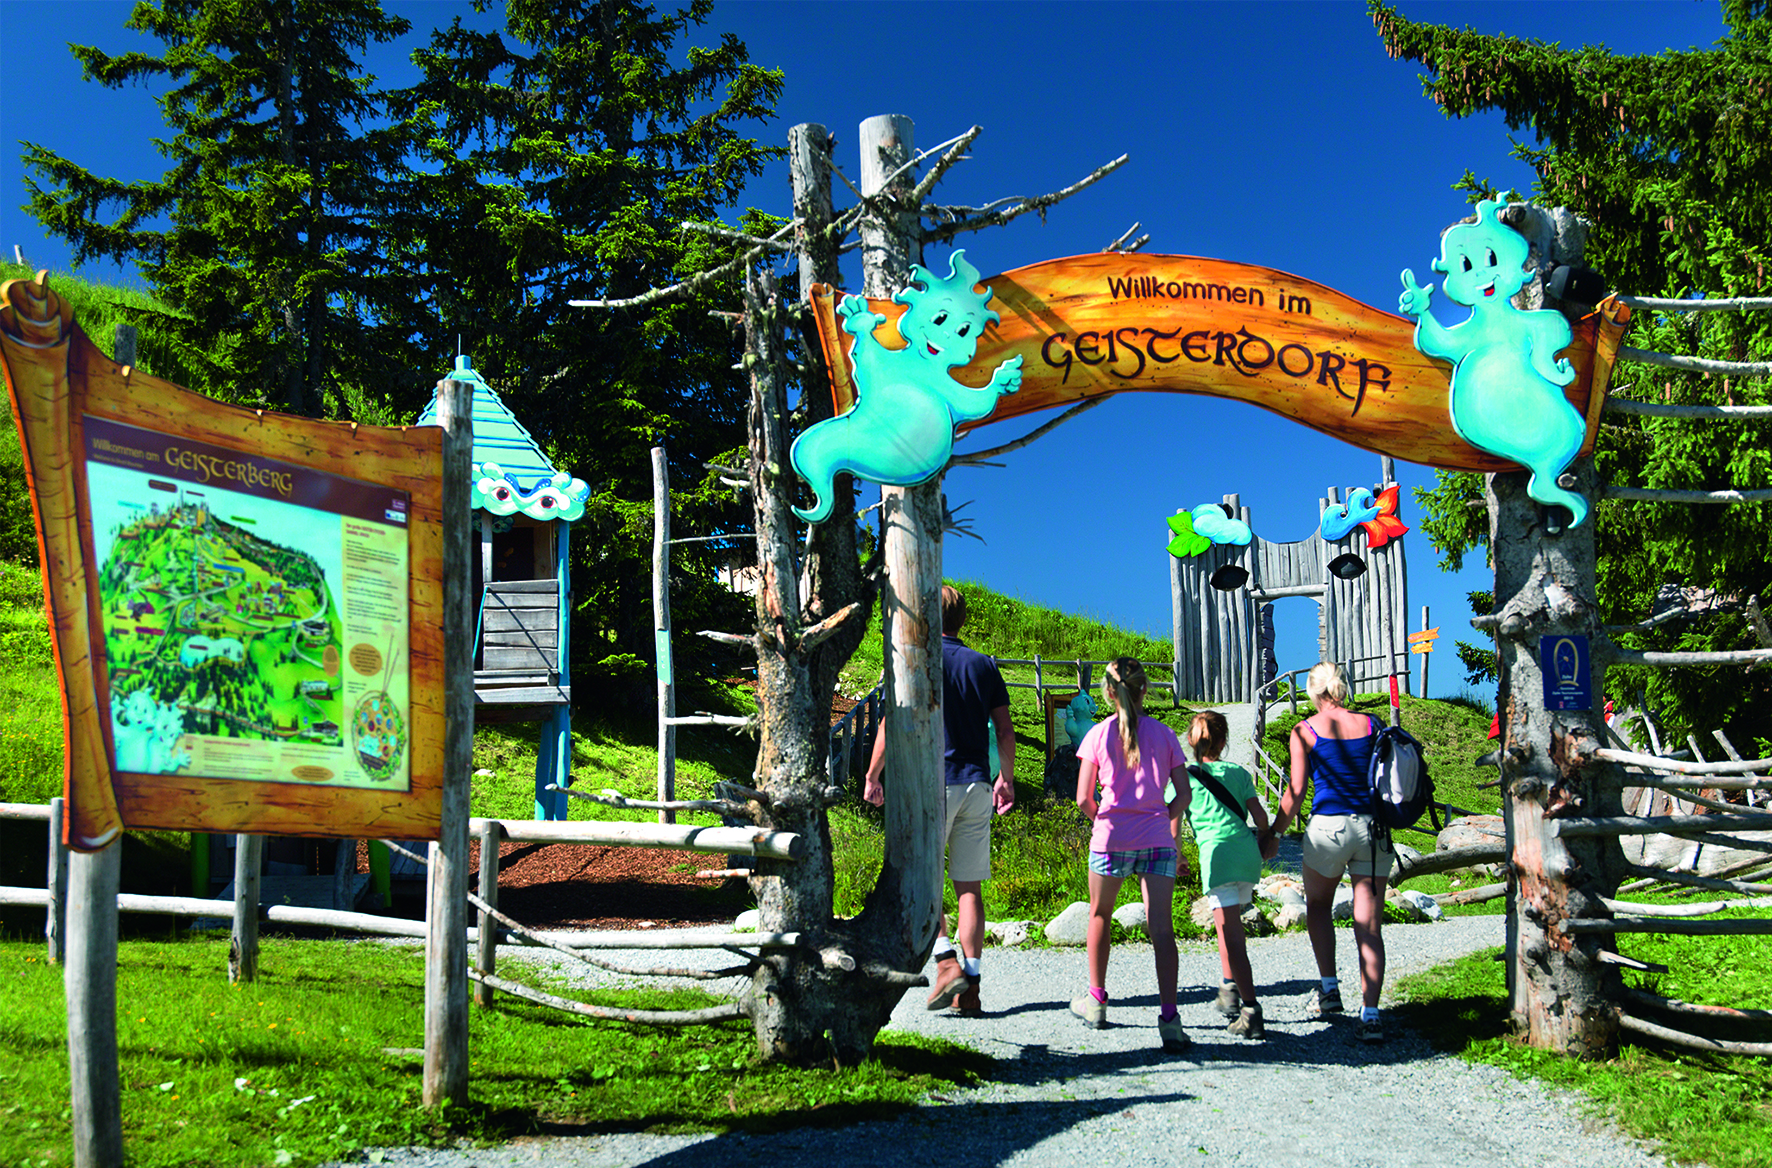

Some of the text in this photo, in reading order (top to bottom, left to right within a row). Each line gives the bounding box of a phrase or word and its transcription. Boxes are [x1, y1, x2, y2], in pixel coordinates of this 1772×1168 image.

[1107, 276, 1311, 315] Willkommen im
[1041, 325, 1392, 418] GEISTERDORF
[92, 438, 145, 460] Willkommen
[146, 451, 160, 462] am
[164, 447, 294, 498] GEISTERBERG
